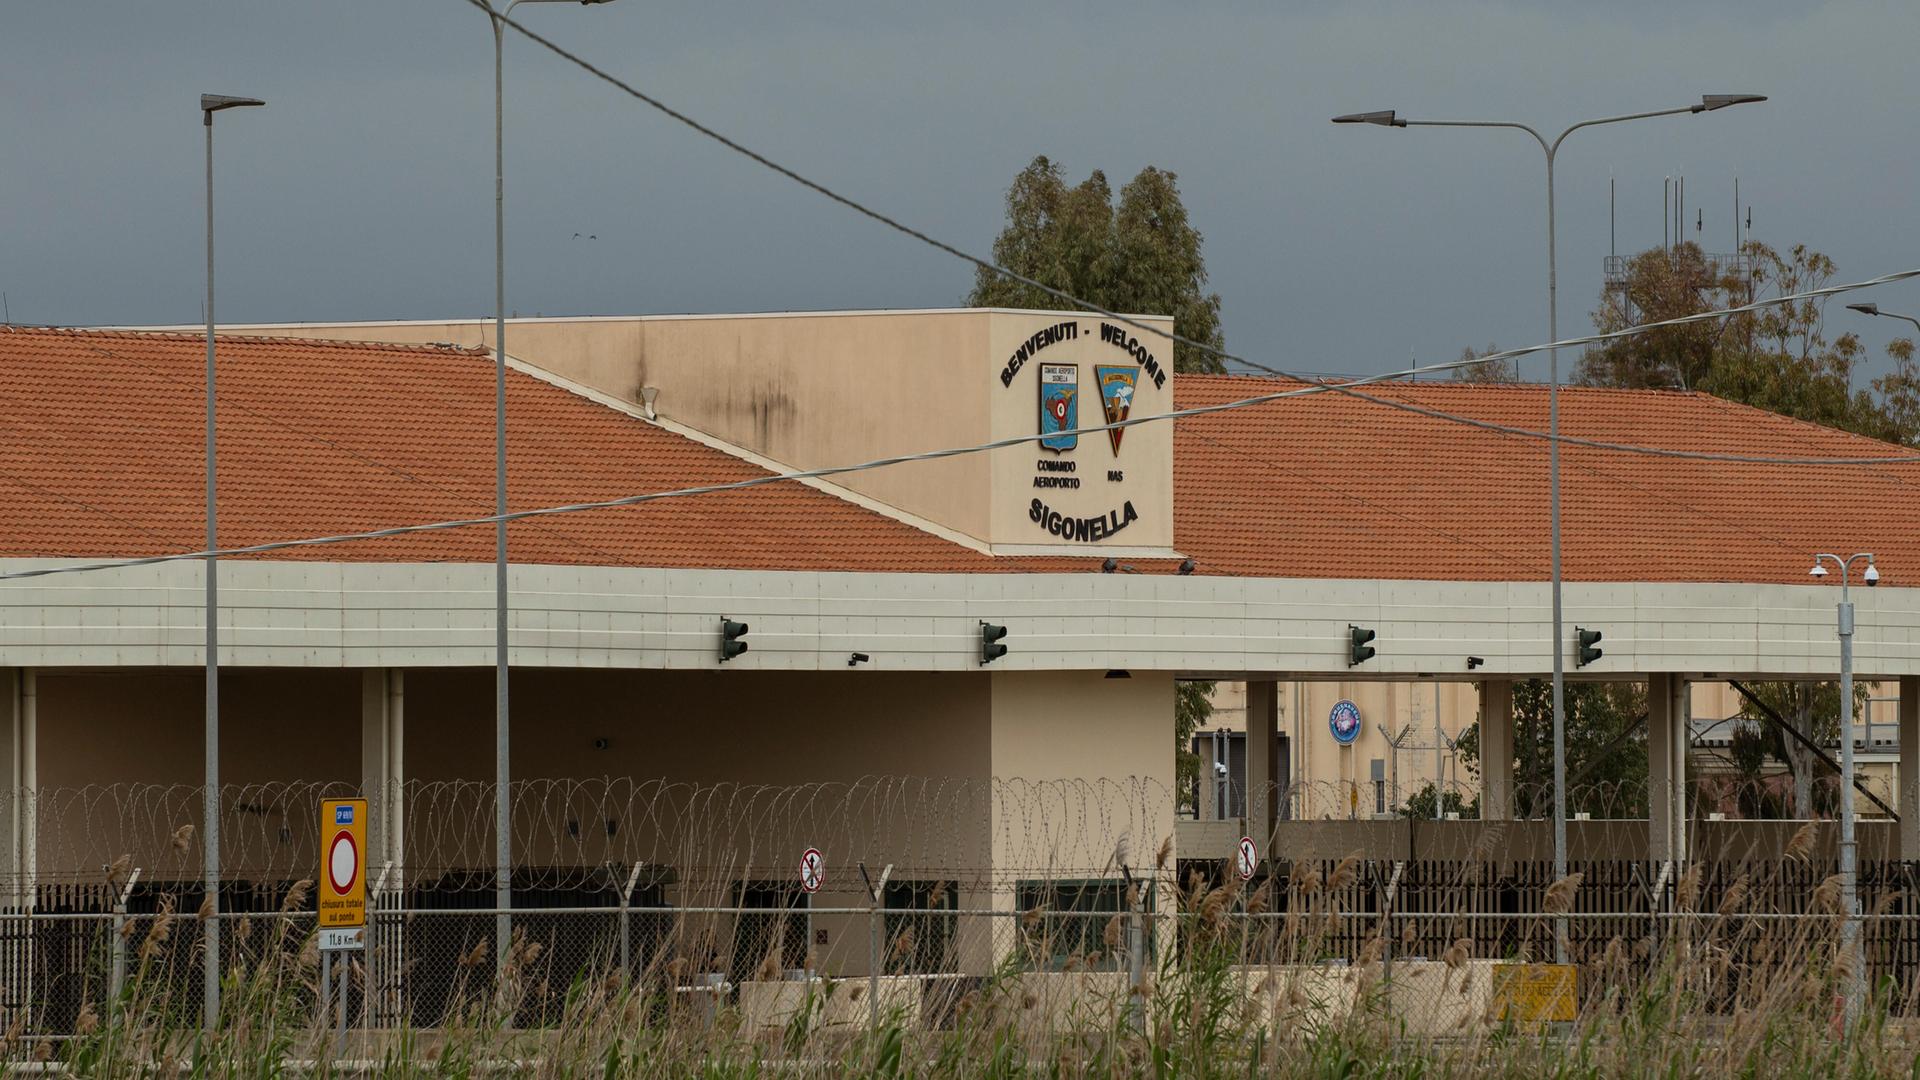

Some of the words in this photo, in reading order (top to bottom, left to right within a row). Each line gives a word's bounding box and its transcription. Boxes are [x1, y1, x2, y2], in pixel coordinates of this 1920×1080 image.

[1000, 322, 1077, 388] BENVENUTI
[1101, 322, 1166, 390] WELCOME
[1037, 460, 1076, 472] COMANDO
[1107, 470, 1123, 482] NAS
[1033, 477, 1080, 489] AEROPORTO
[1029, 498, 1138, 542] SIGONELLA
[321, 899, 344, 909] chiusura
[346, 898, 363, 908] totale
[329, 912, 337, 921] sul
[339, 912, 355, 922] ponte
[344, 935, 353, 945] Km
